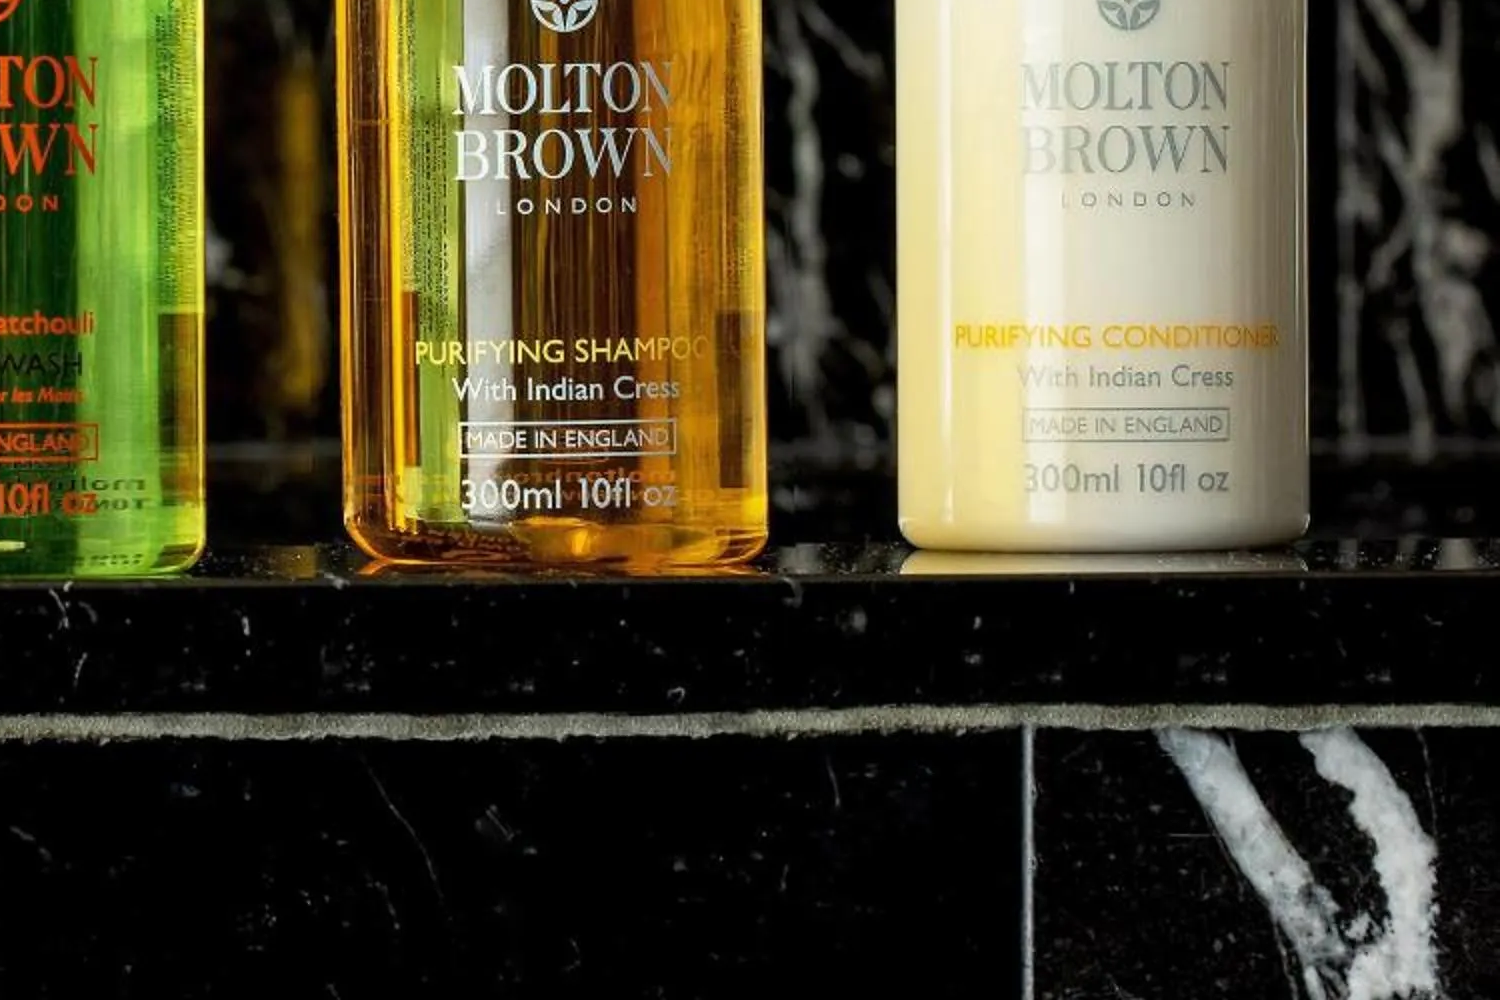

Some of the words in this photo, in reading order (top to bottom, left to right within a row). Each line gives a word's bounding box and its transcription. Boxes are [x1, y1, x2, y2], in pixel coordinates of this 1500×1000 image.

[452, 62, 674, 114] MOLTON
[1020, 61, 1230, 111] MOLTON
[453, 128, 674, 181] BROWN
[1020, 126, 1230, 174] BROWN
[497, 198, 637, 215] LONDON
[1063, 191, 1195, 208] LONDON
[955, 325, 1091, 348] PURIFYING
[1102, 325, 1279, 348] CONDITIONER
[416, 338, 565, 365] PURIFYING
[452, 377, 517, 402] With
[528, 377, 604, 401] Indian
[613, 376, 680, 399] Cress
[1017, 366, 1078, 387] With
[1089, 365, 1161, 387] Indian
[1171, 365, 1233, 387] Cress
[1029, 416, 1087, 434] MADE
[1095, 416, 1115, 434] IN
[1125, 416, 1223, 434] ENGLAND
[466, 431, 526, 449] MADE
[534, 431, 557, 449] IN
[565, 429, 669, 448] ENGLAND
[1023, 464, 1120, 492] 300ml
[1137, 464, 1185, 492] 10fl
[1198, 472, 1229, 492] oz
[63, 493, 98, 515] oz
[461, 480, 562, 510] 300ml
[579, 478, 631, 509] 10fl
[643, 485, 679, 507] oz
